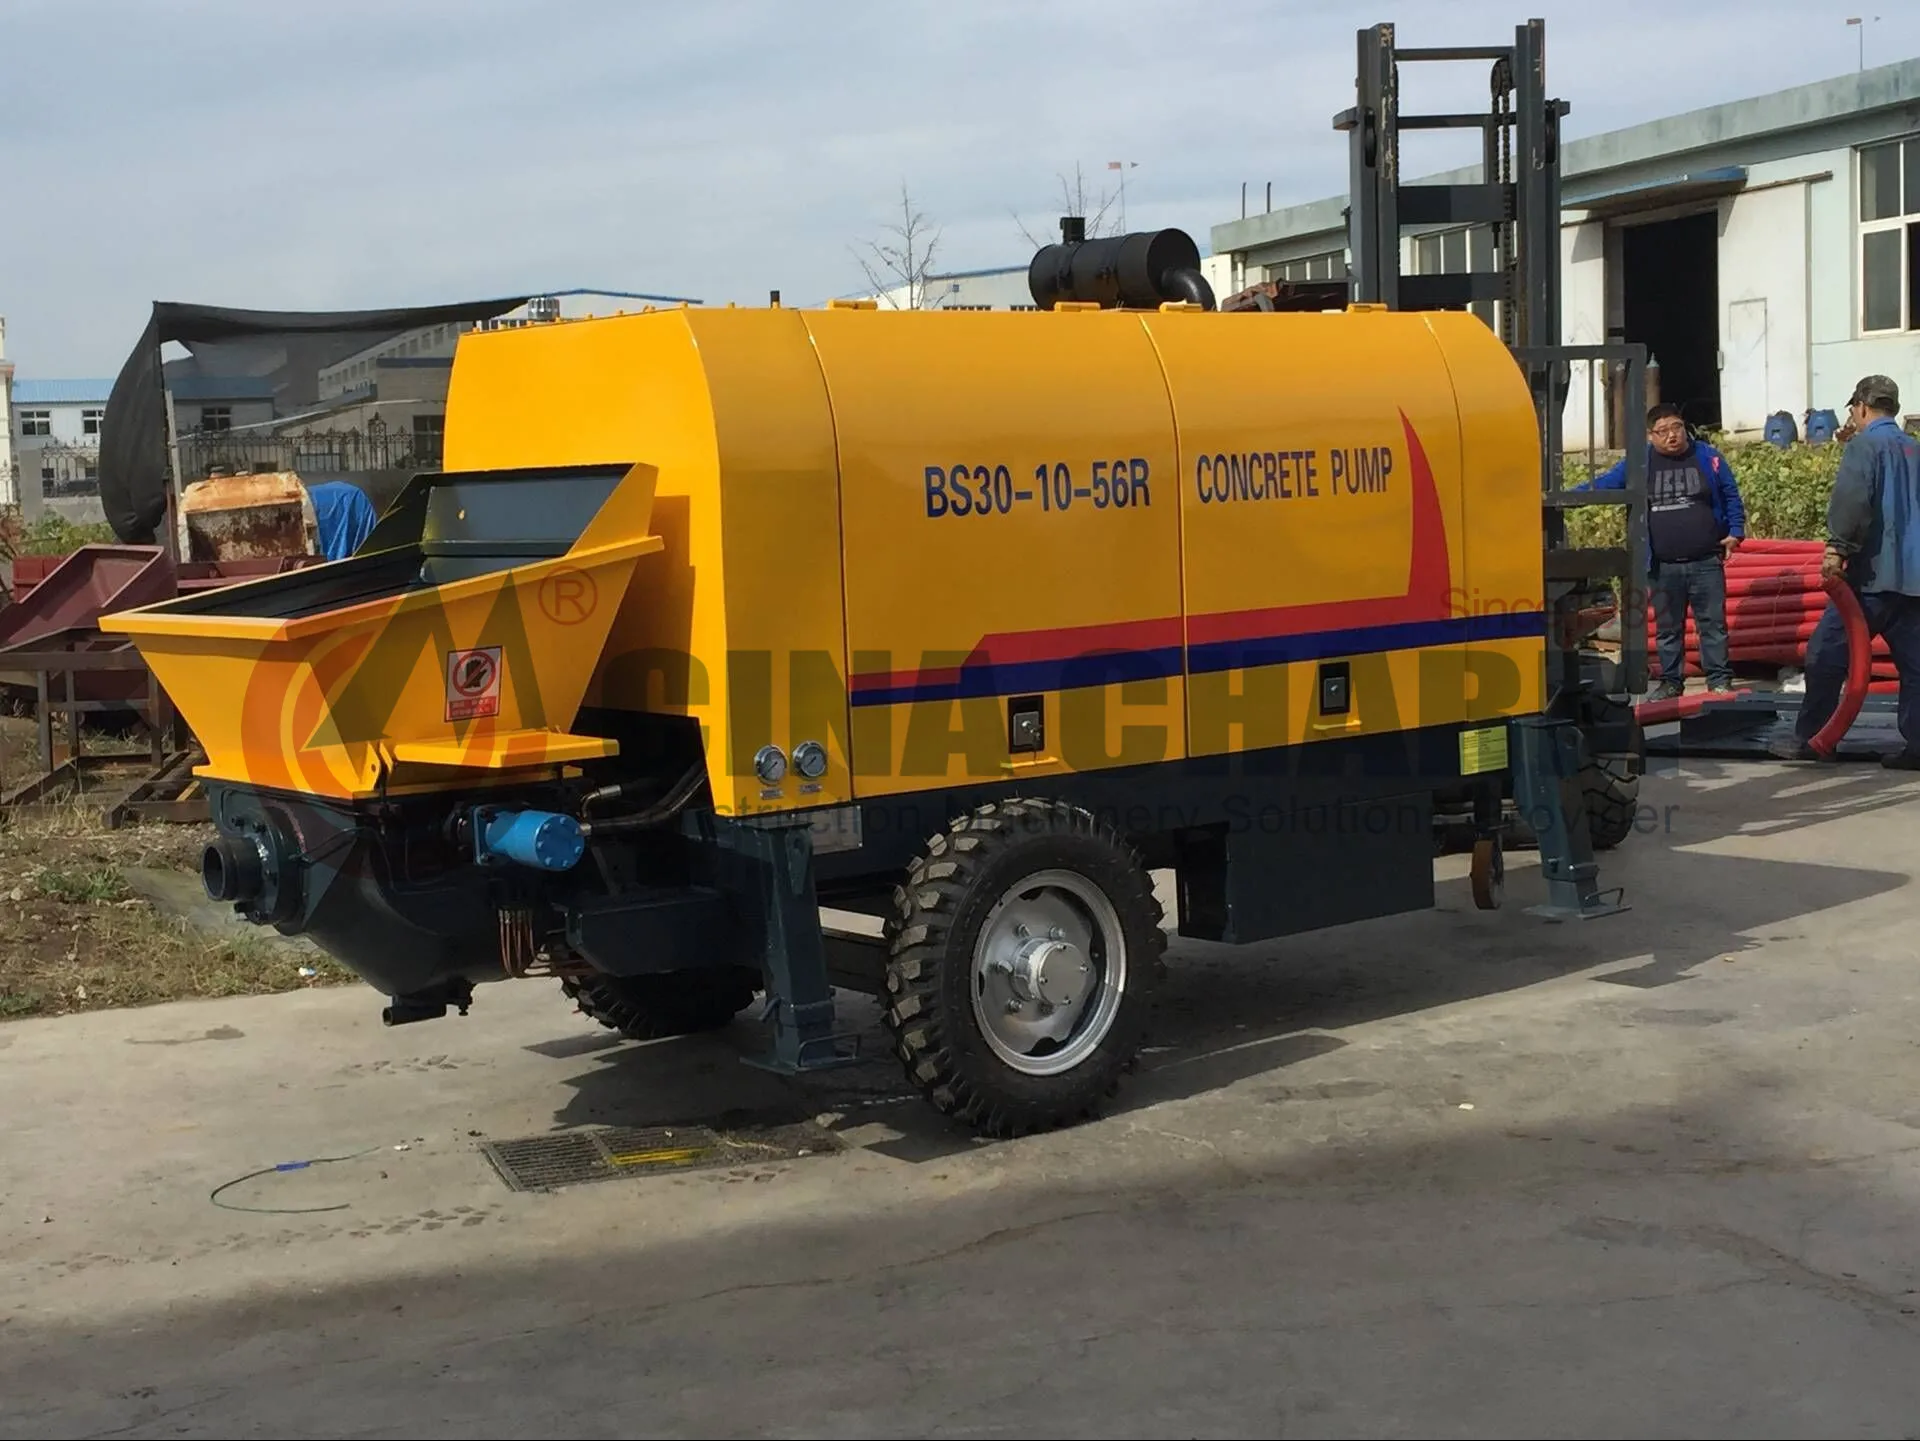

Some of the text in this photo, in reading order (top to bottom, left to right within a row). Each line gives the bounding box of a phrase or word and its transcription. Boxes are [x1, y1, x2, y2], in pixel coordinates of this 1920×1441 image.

[924, 446, 1393, 518] BS30-10-56R CONCRETE PUMP
